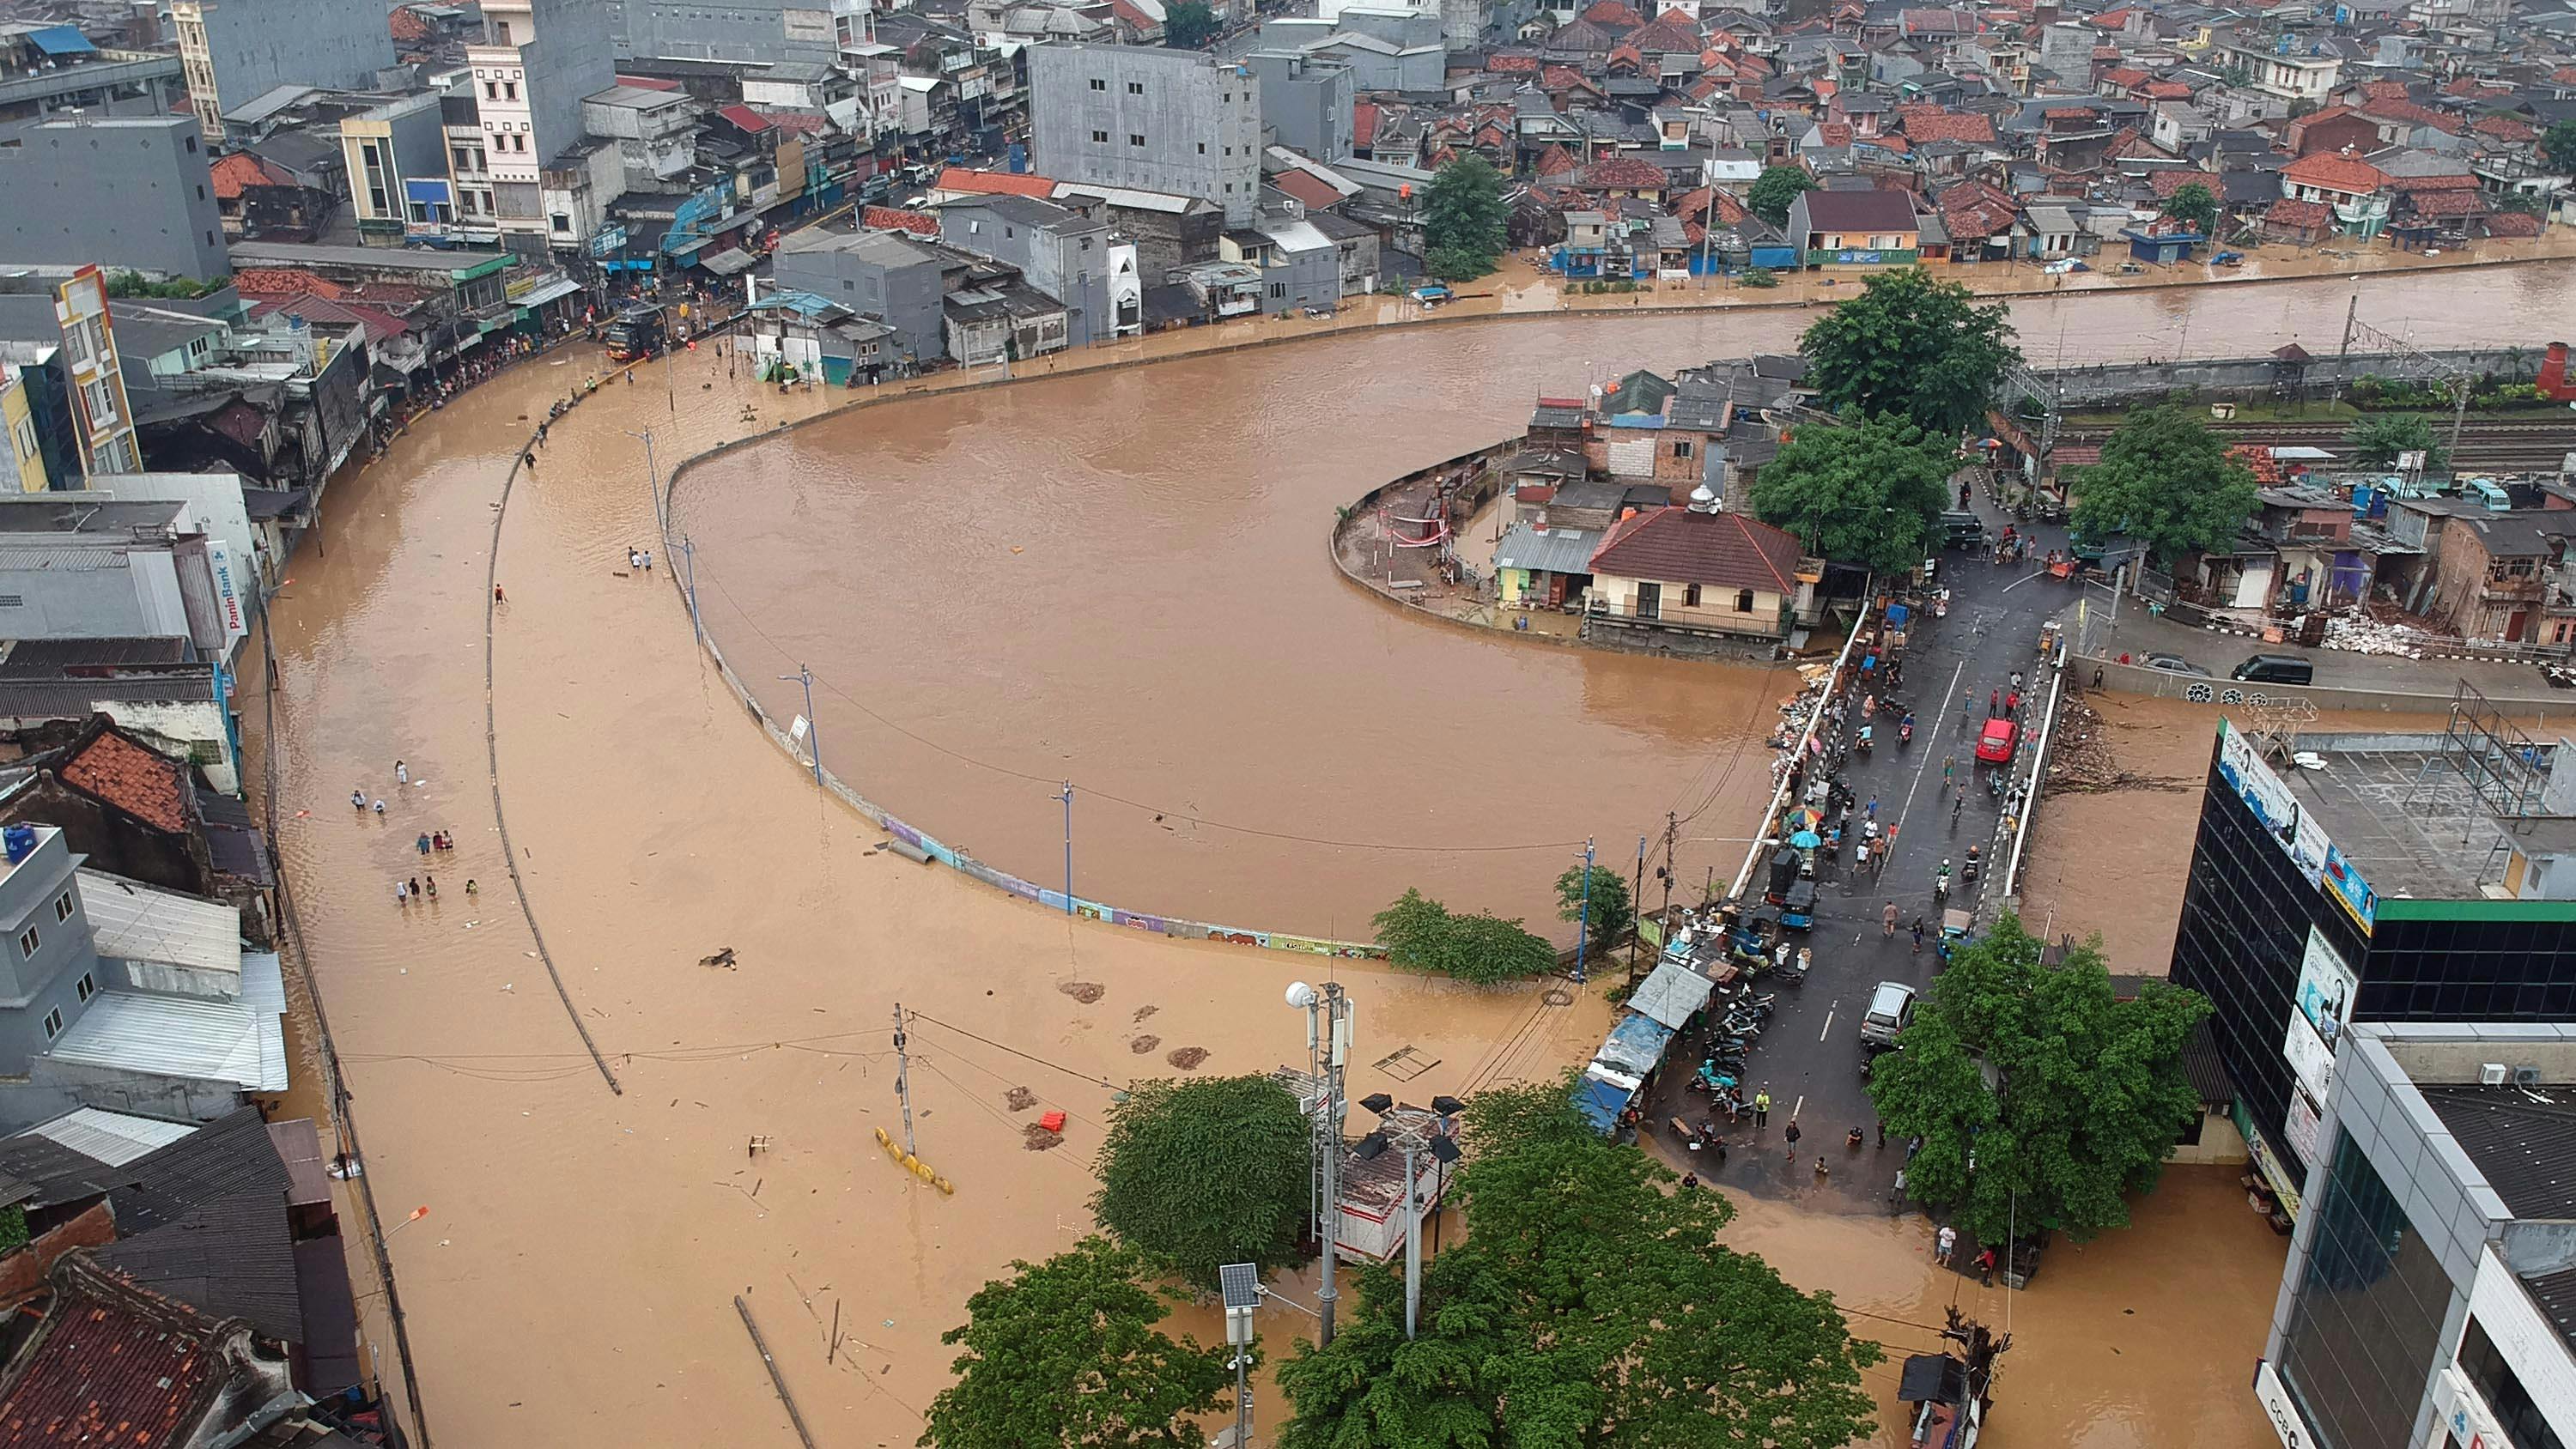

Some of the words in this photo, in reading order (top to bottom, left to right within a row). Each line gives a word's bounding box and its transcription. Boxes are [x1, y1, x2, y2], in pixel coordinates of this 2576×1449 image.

[217, 566, 240, 629] PaninBank
[2312, 930, 2323, 948] TOKO
[2321, 943, 2336, 963] INDAH
[2333, 958, 2343, 975] JAYA
[2342, 969, 2355, 988] BARU
[2269, 1397, 2289, 1435] CCB
